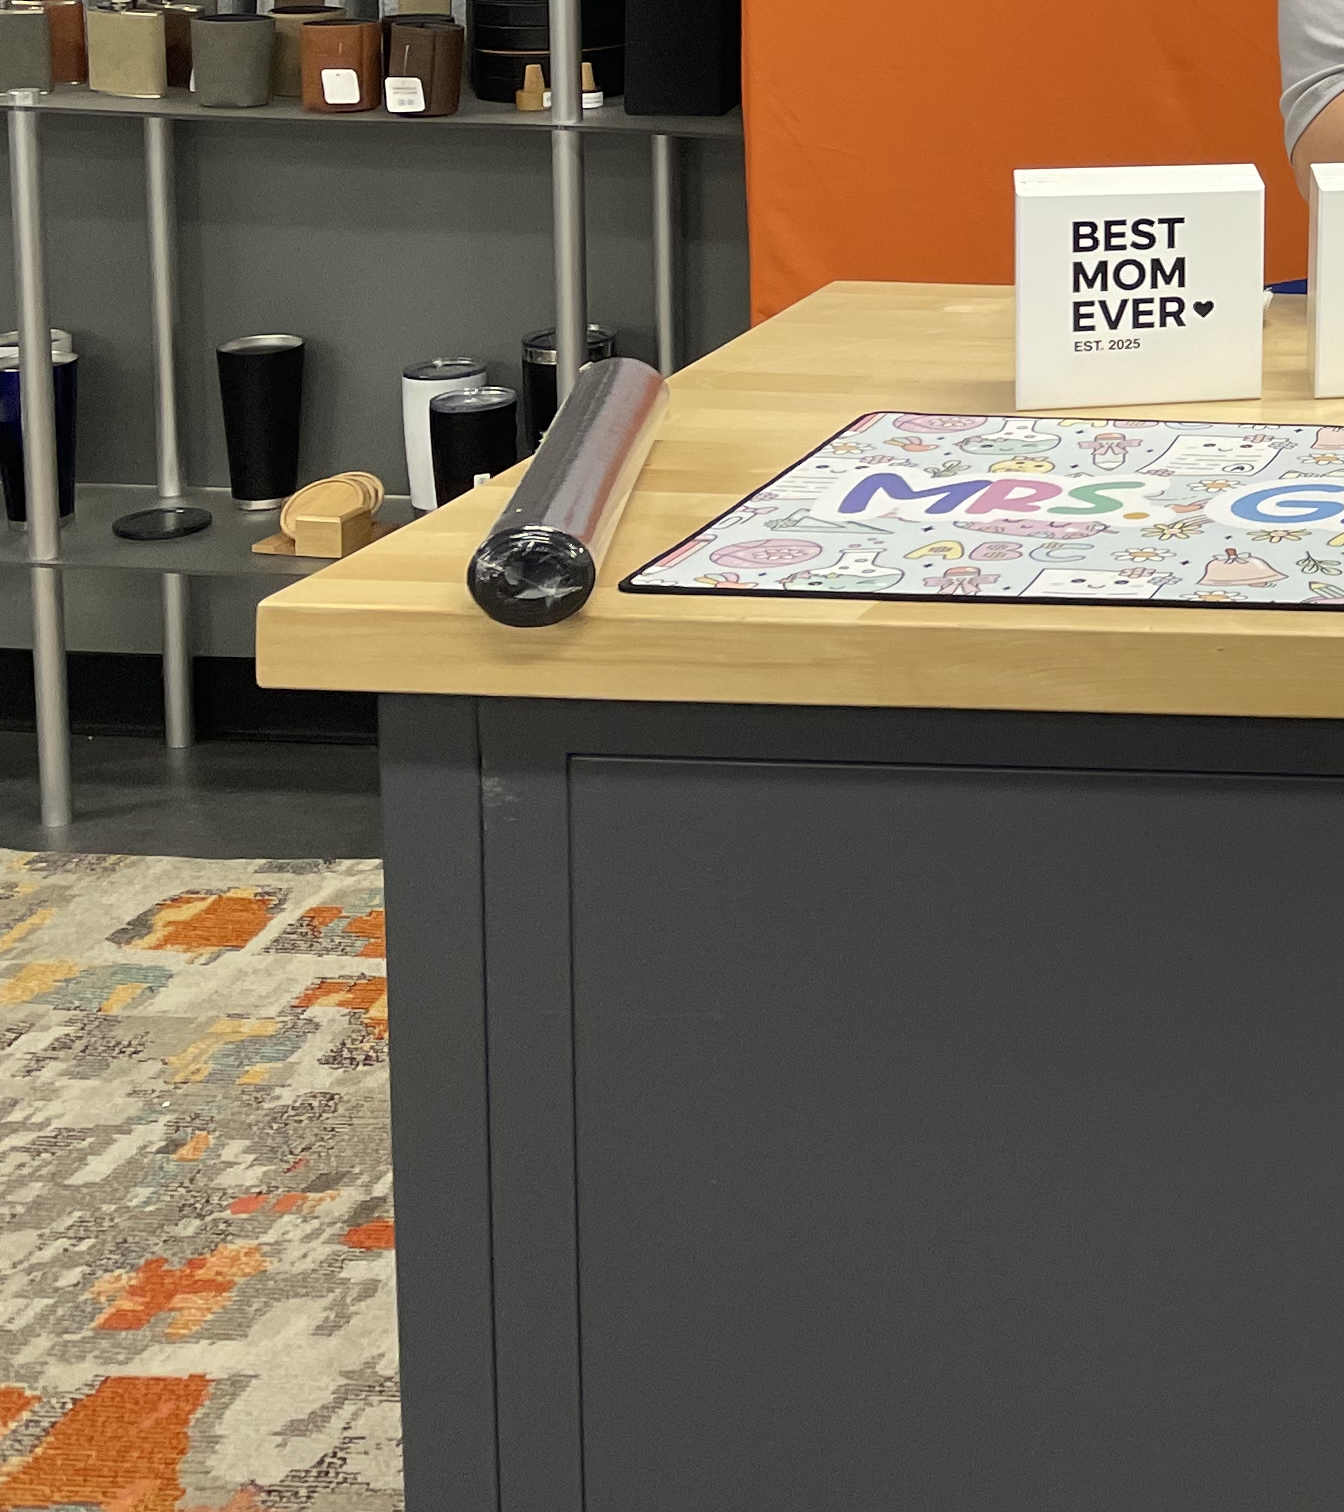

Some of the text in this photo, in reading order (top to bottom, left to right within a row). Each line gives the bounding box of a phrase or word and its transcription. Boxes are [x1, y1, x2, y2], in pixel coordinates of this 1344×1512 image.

[1071, 216, 1186, 253] BEST
[1071, 256, 1187, 293] MOM
[1071, 296, 1187, 333] EVER
[1074, 337, 1141, 352] EST. 2025
[837, 472, 1151, 520] MRS.
